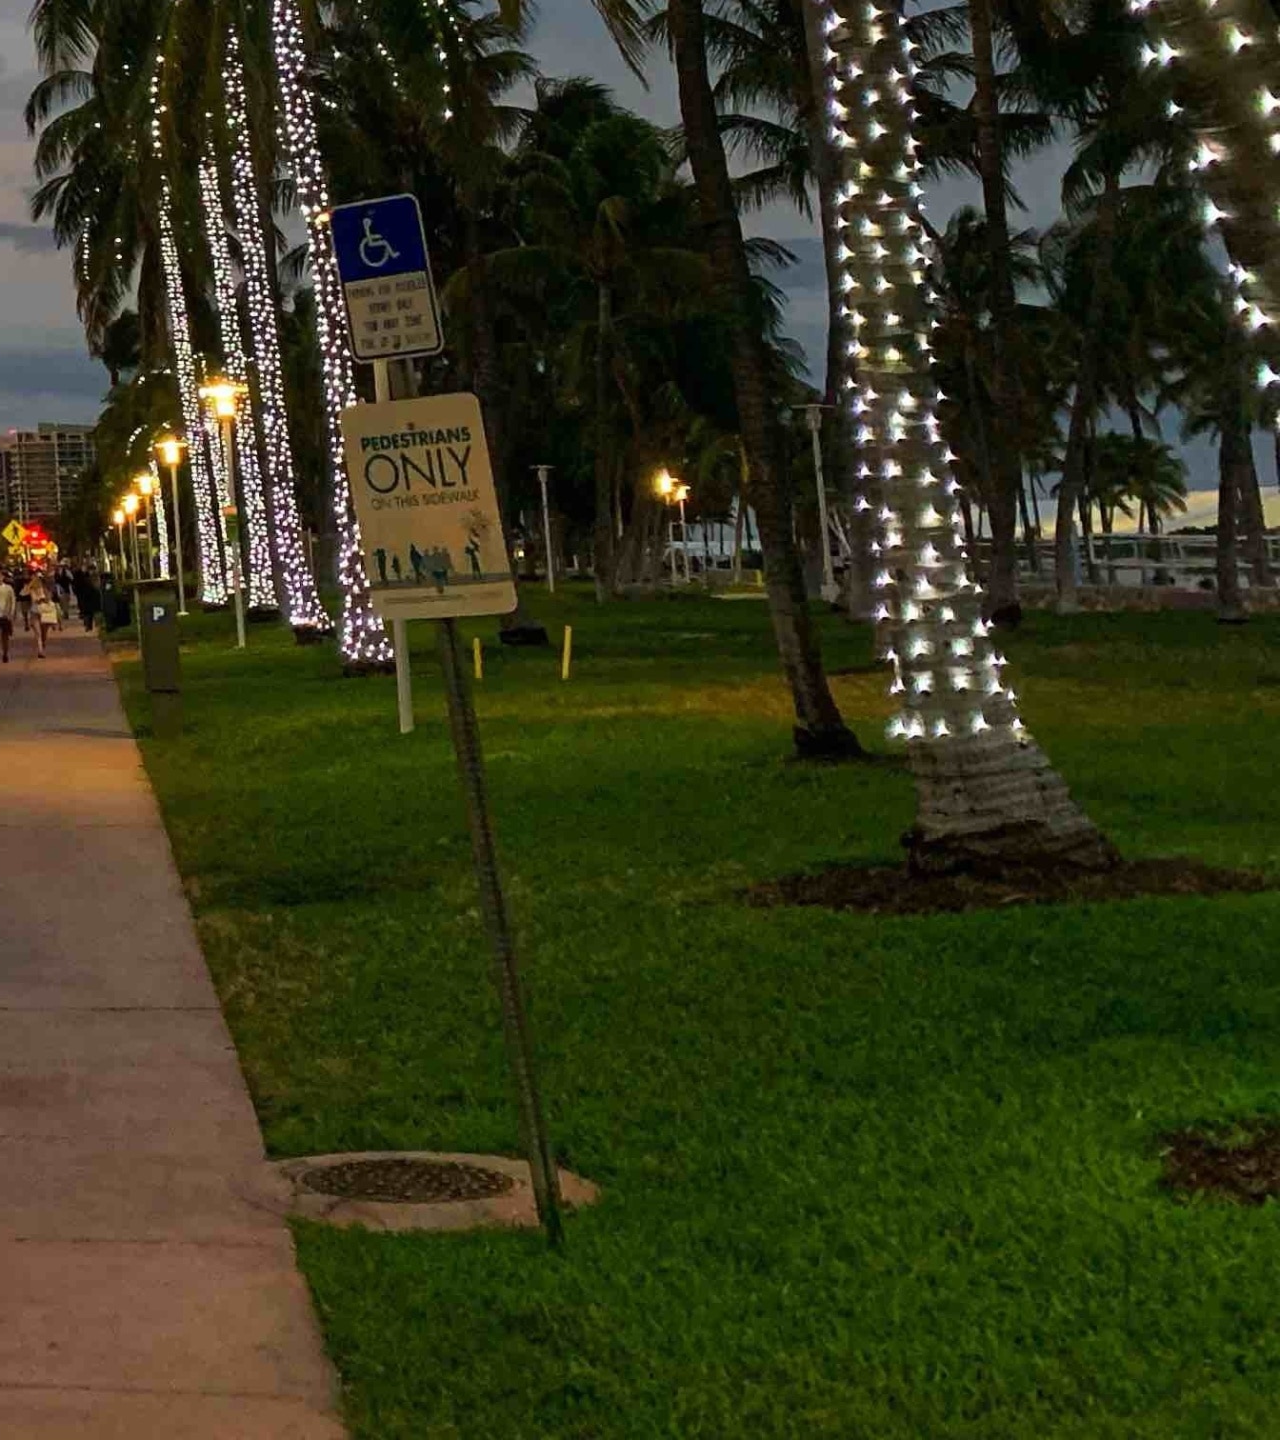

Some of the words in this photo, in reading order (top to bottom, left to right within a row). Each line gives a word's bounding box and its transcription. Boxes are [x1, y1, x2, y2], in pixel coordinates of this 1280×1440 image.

[361, 426, 471, 452] PEDESTRIANS
[365, 445, 471, 493] ONLY
[395, 495, 420, 508] THIS
[422, 488, 480, 506] SIDEWALK
[153, 606, 165, 621] P
